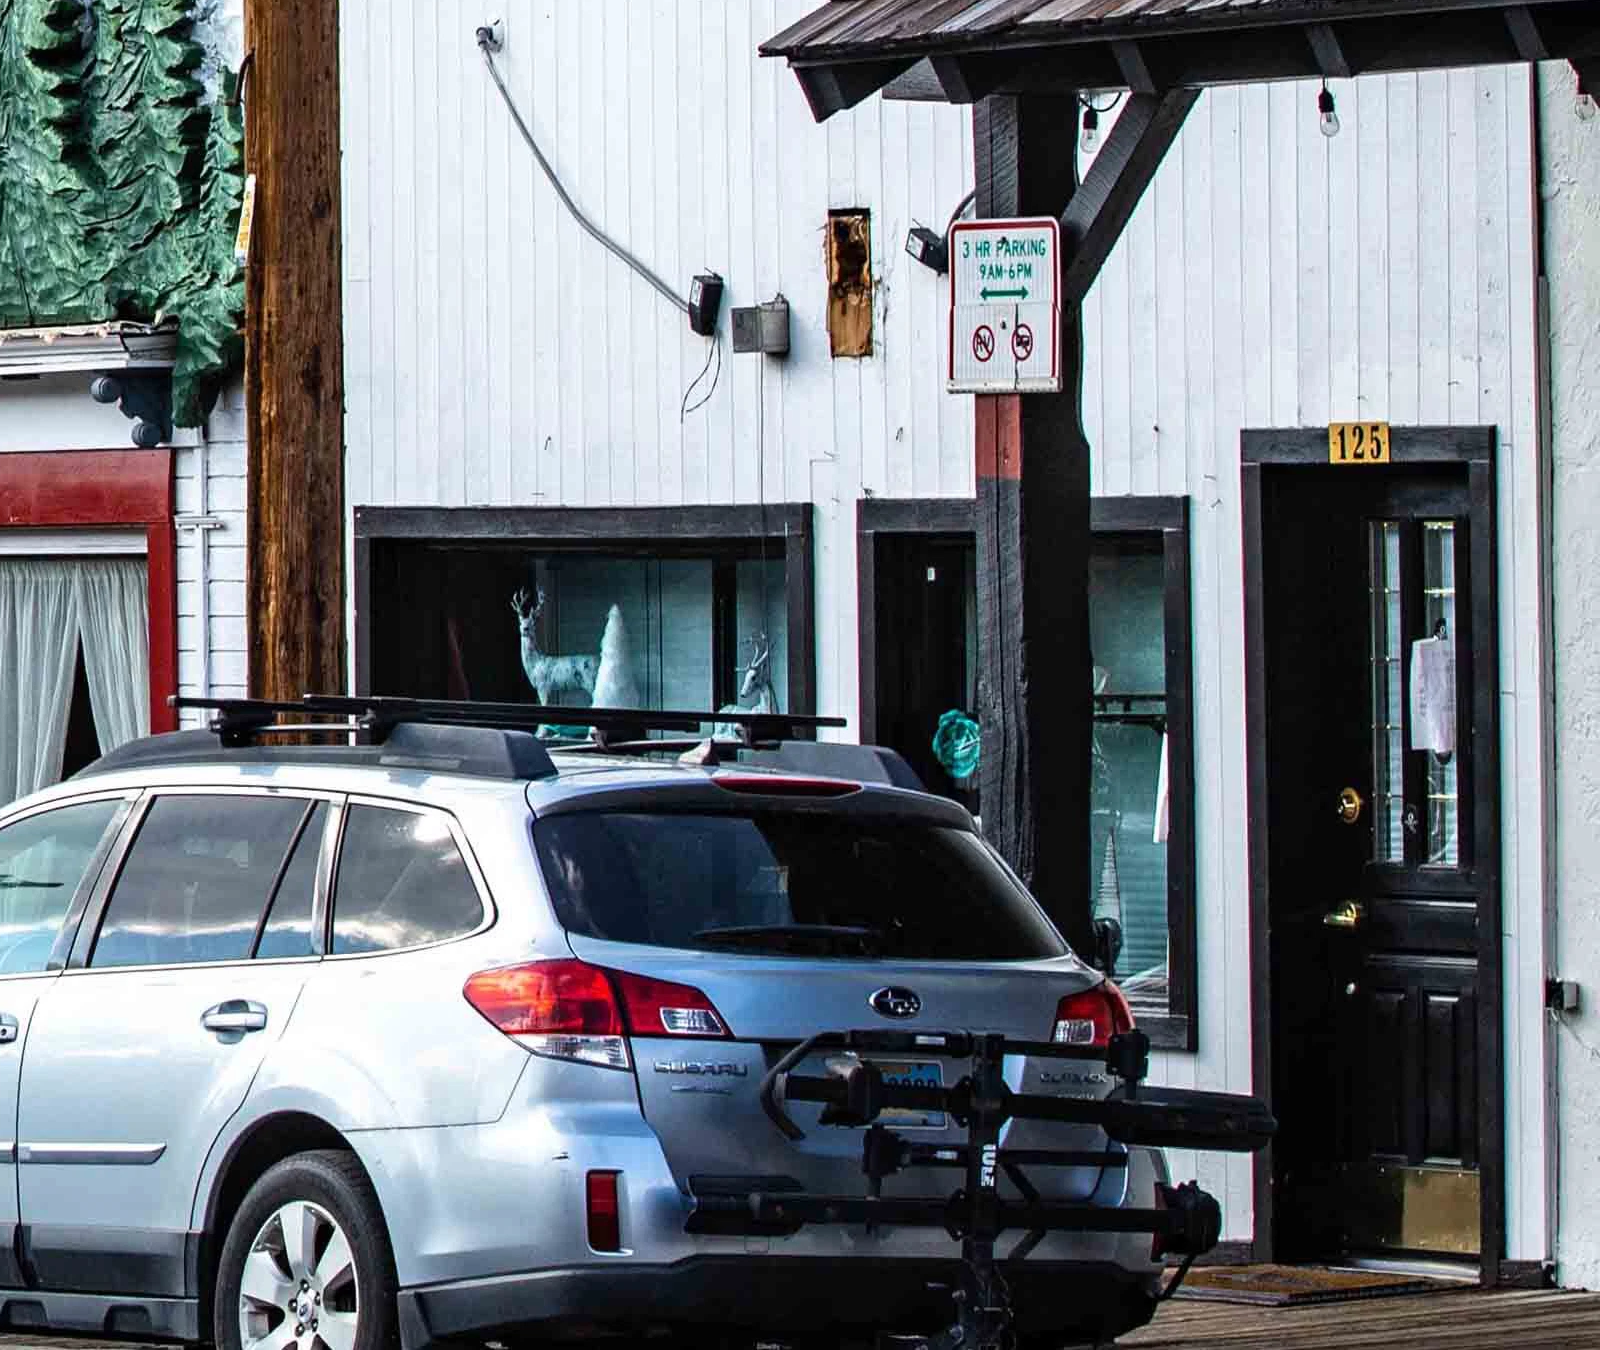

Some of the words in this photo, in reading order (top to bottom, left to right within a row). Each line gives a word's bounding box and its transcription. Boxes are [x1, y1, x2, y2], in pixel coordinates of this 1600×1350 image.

[962, 242, 970, 258] 3
[975, 240, 991, 258] HR
[996, 238, 1047, 257] PARKING
[1336, 425, 1382, 460] 125
[652, 1059, 748, 1076] SUBARU
